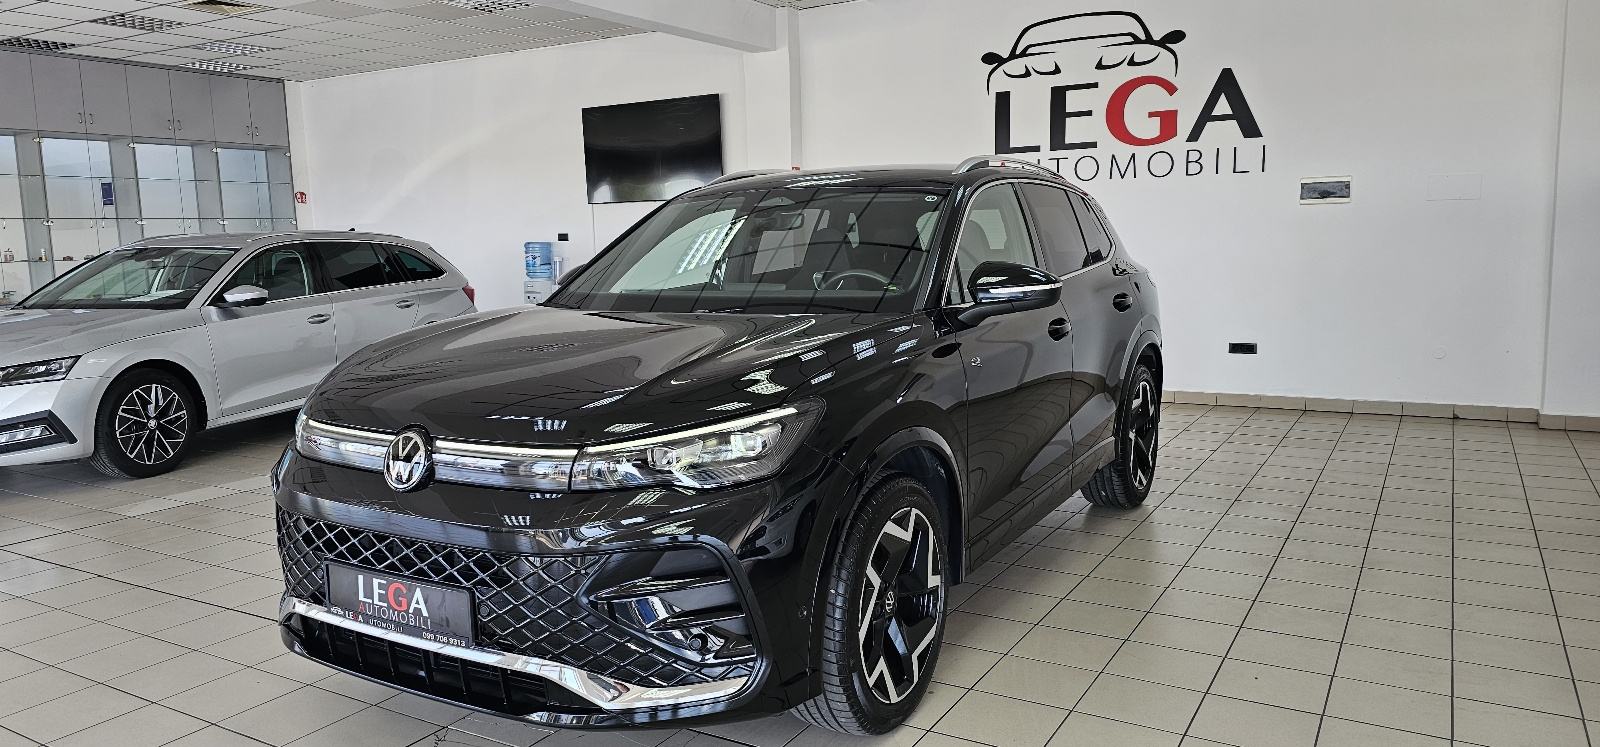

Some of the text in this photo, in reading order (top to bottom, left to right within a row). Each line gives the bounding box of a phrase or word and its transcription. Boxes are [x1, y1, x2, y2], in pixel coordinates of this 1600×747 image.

[995, 67, 1263, 155] LEGA
[1037, 145, 1265, 181] TOMOBILI
[358, 575, 428, 617] LEGA
[358, 602, 431, 629] AUTOMOBILI
[368, 619, 403, 632] UTOMOBILI
